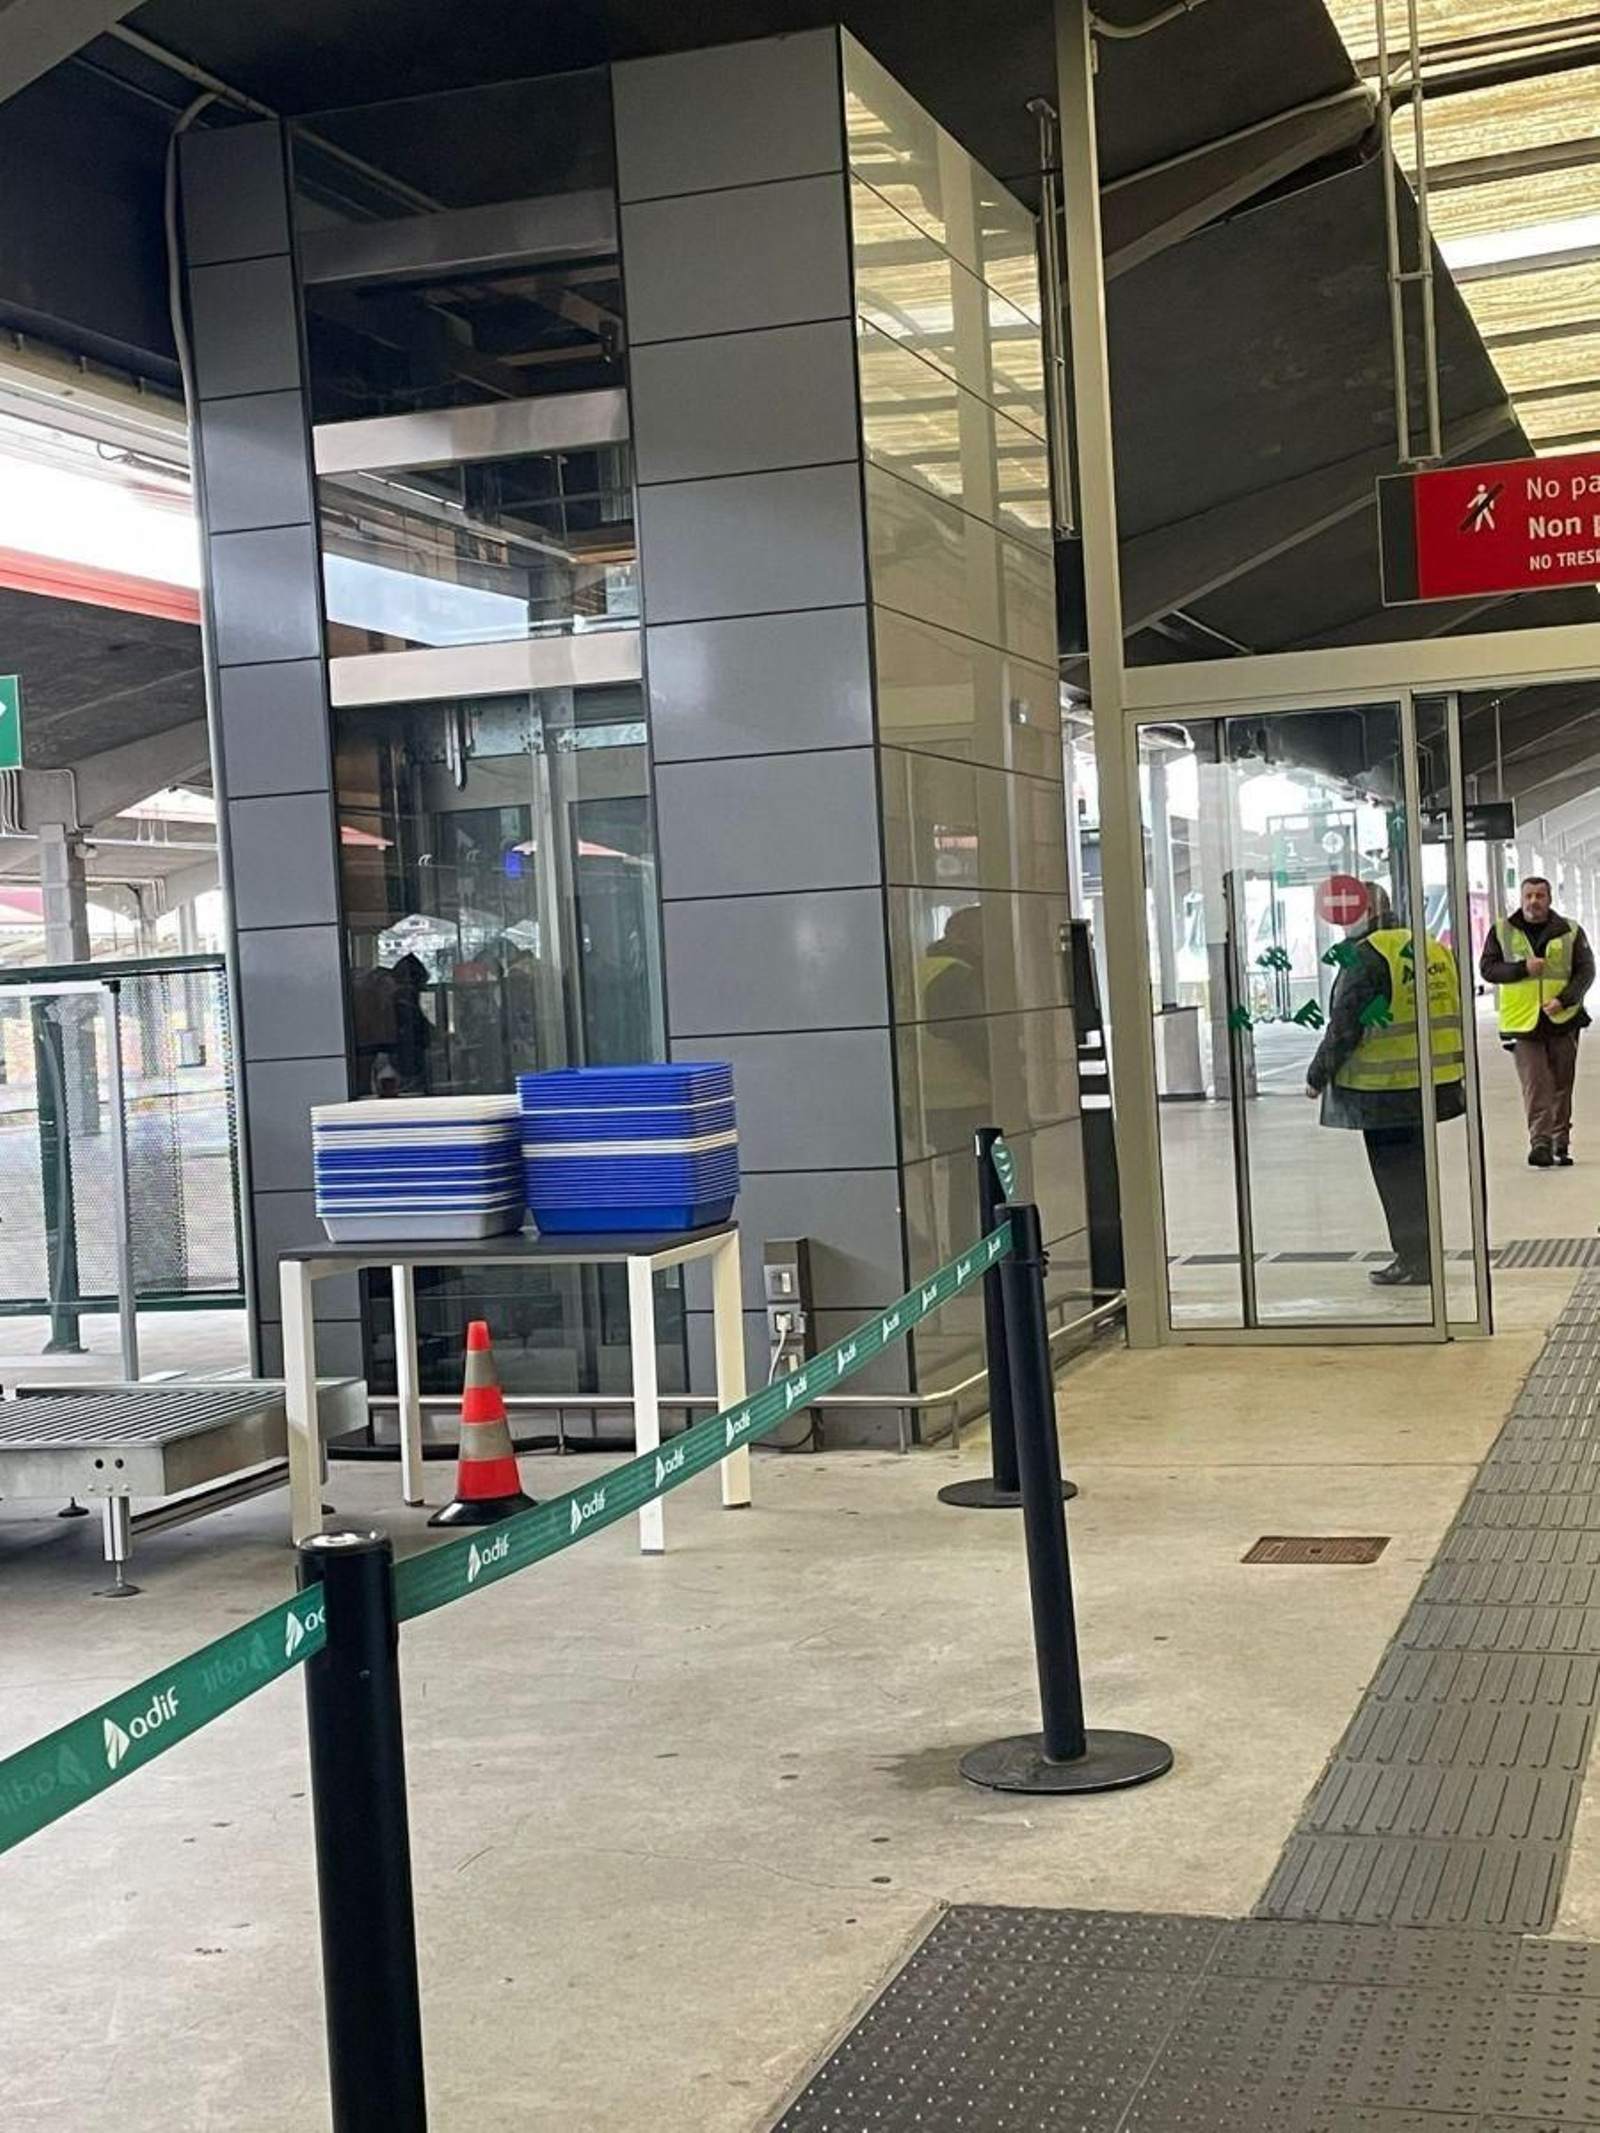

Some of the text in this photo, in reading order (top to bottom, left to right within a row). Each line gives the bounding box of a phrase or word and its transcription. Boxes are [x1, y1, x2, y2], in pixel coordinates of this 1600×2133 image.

[1527, 476, 1560, 500] No
[1529, 515, 1582, 540] Non
[1529, 554, 1552, 571] NO
[1436, 811, 1453, 840] 1
[664, 1445, 685, 1474] adif
[581, 1486, 606, 1519] adif
[481, 1532, 511, 1565] adif
[129, 1685, 179, 1739] adif
